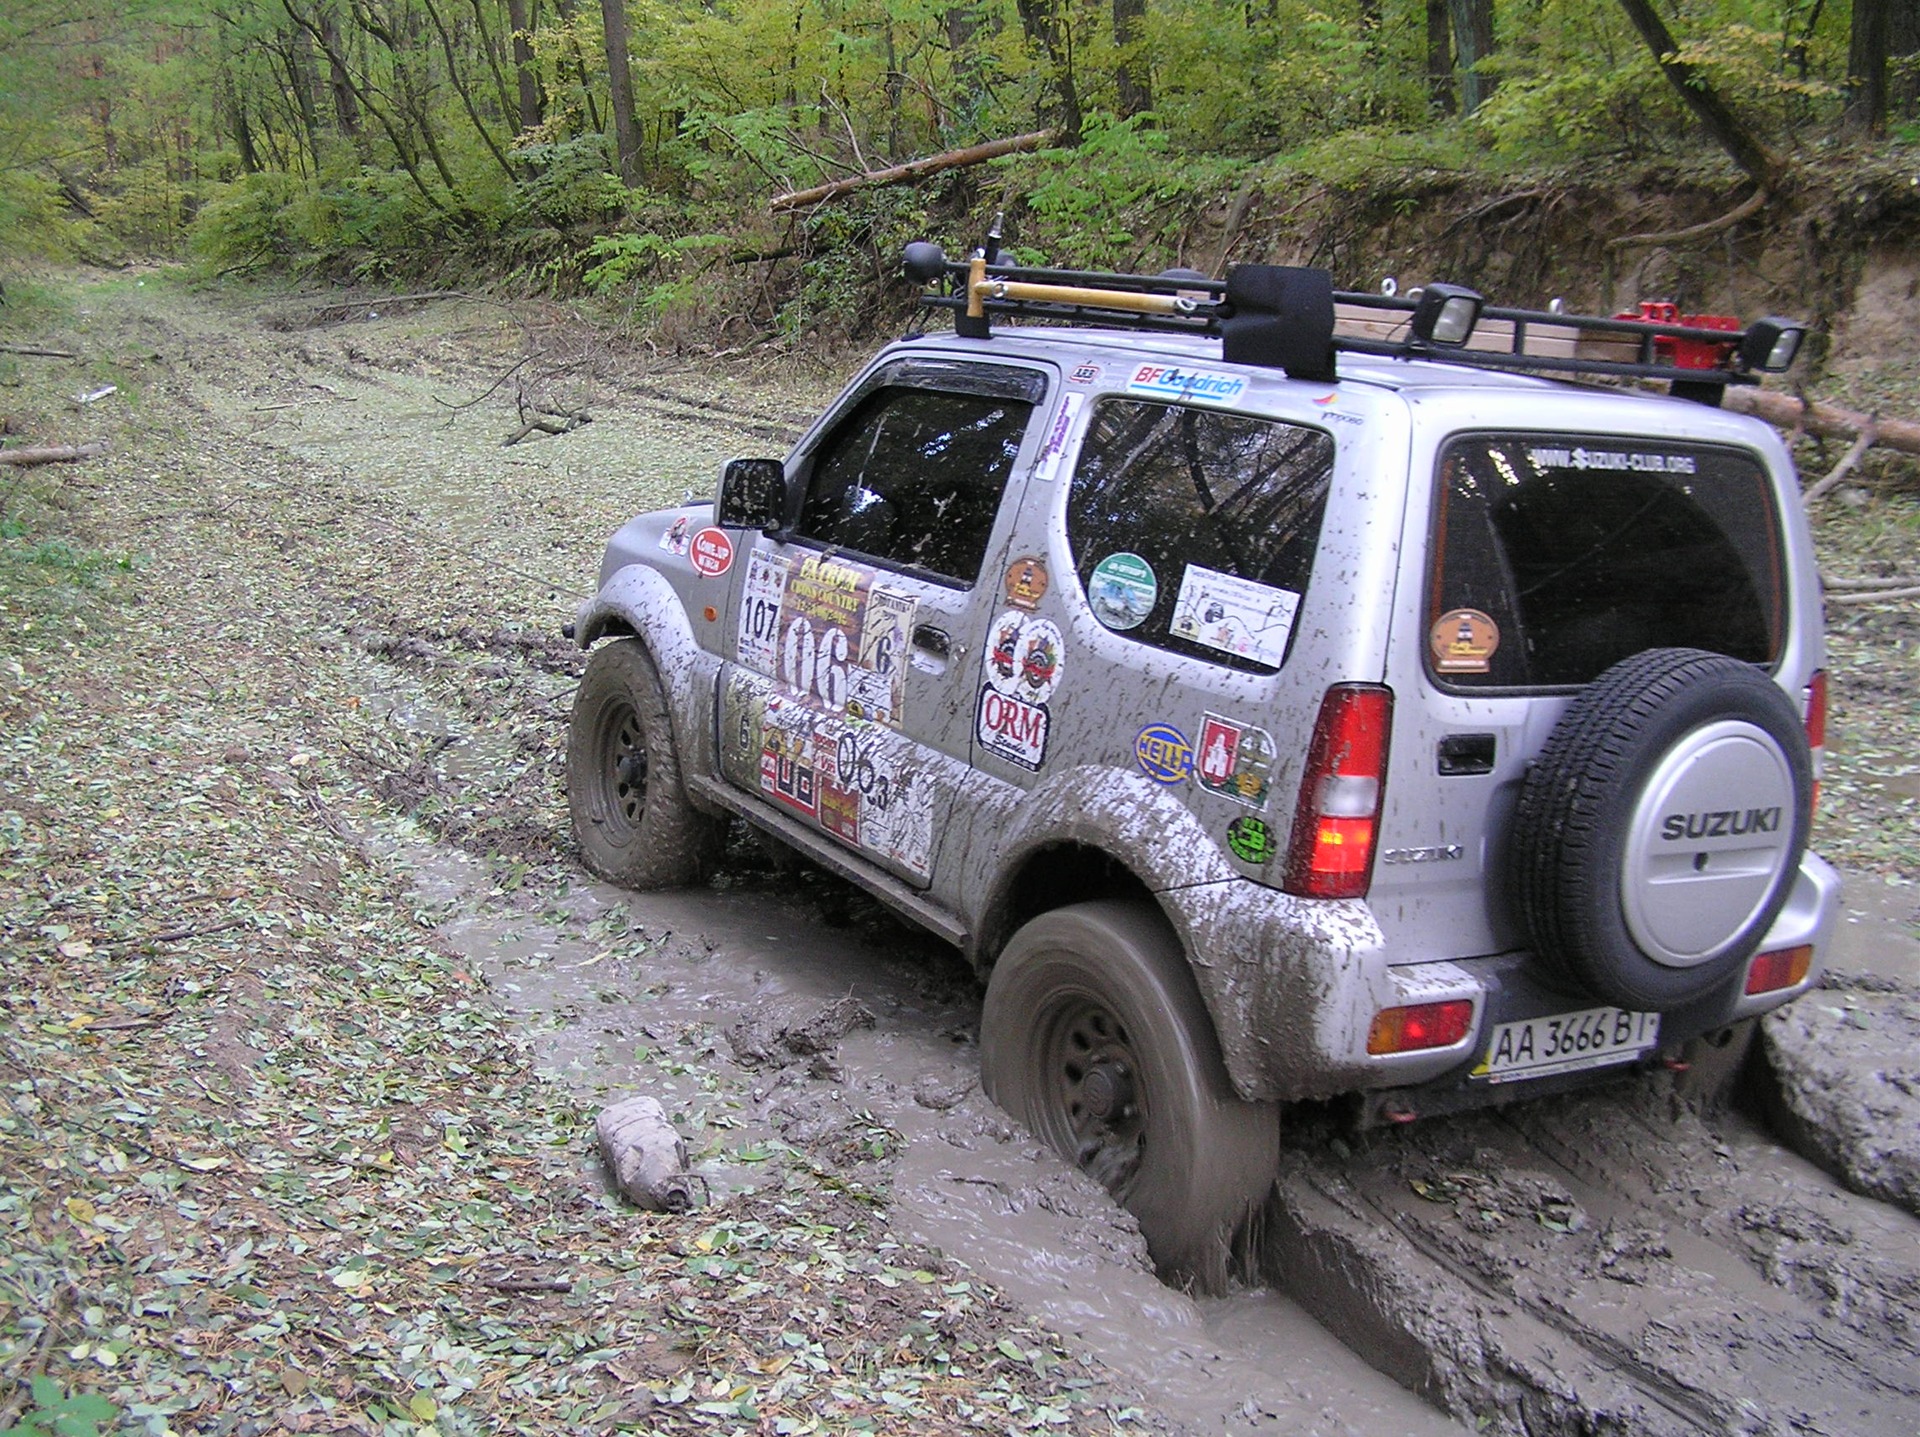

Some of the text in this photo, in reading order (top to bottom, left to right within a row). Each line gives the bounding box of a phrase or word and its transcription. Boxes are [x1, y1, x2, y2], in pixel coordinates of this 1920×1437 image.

[1135, 366, 1243, 395] BFGoodrich
[745, 596, 778, 641] 107
[784, 617, 848, 712] 06
[985, 693, 1043, 749] ORM
[1660, 807, 1782, 841] SUZUKI
[1382, 843, 1464, 865] SUZUKI
[1492, 1025, 1535, 1066] AA
[1544, 1013, 1608, 1057] 3666
